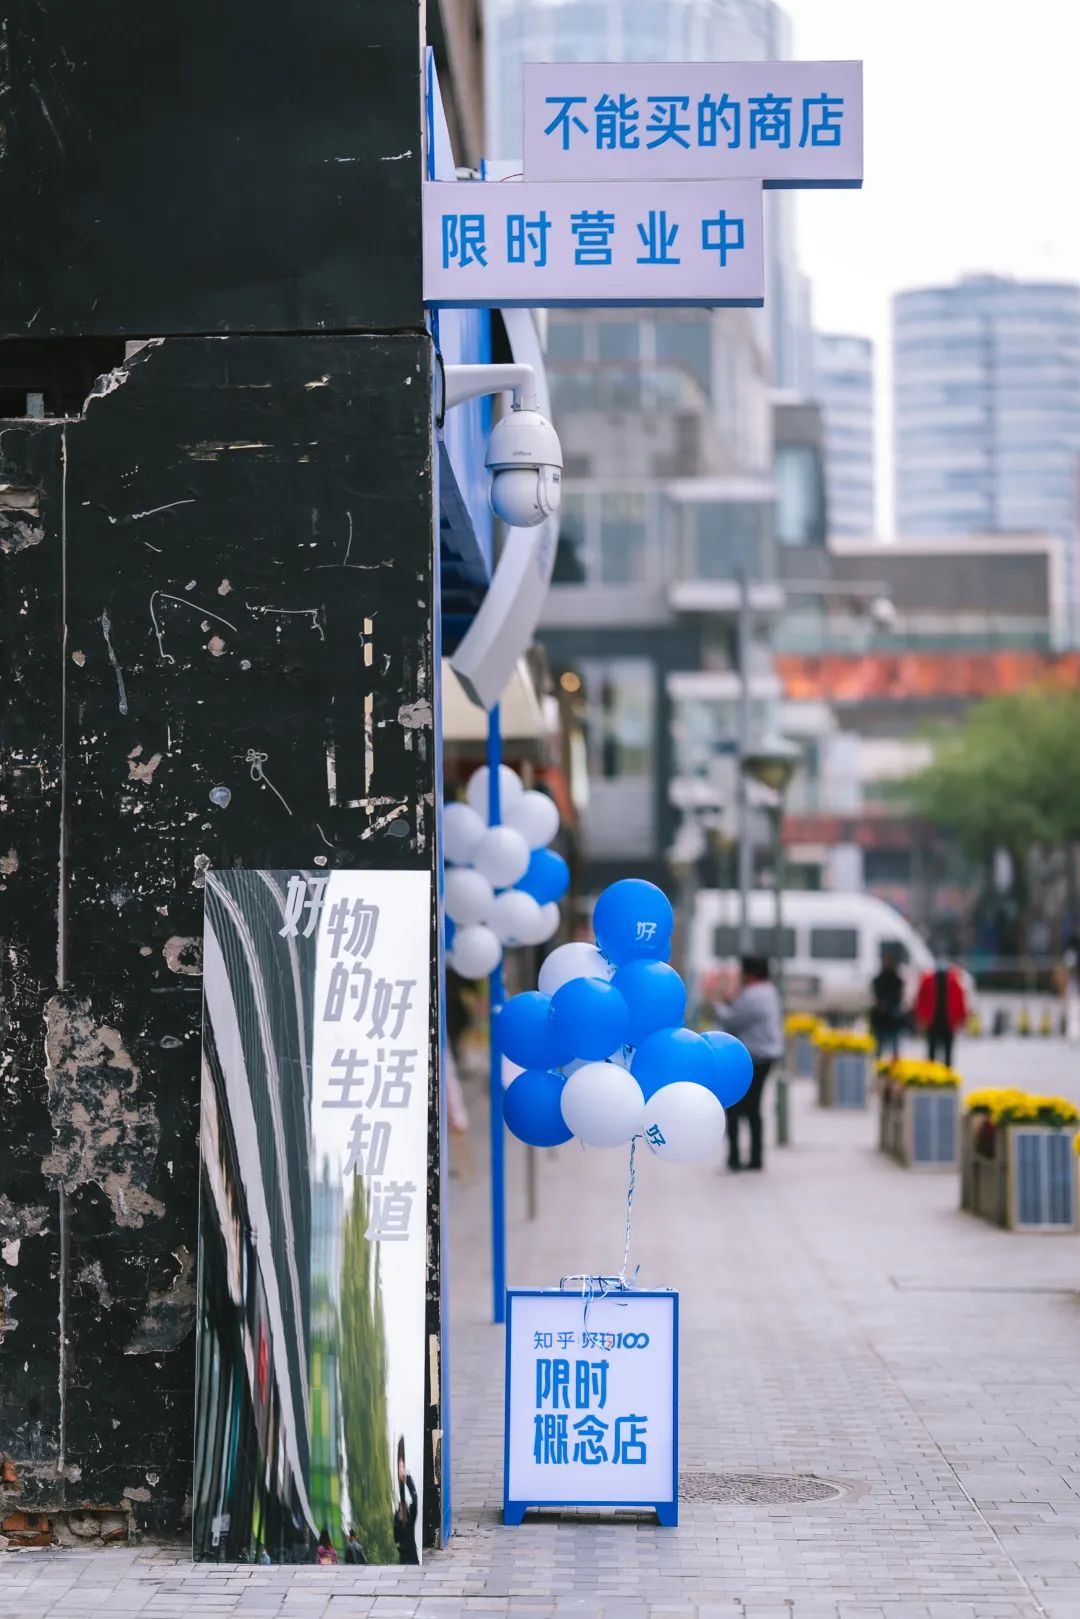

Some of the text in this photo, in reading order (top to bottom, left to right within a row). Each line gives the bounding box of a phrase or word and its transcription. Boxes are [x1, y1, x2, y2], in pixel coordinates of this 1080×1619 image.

[544, 93, 844, 150] 不能买的商店
[441, 210, 745, 269] 限时营业中
[279, 875, 380, 959] 好物
[635, 921, 657, 941] 好
[323, 961, 417, 1040] 的好
[321, 1048, 418, 1109] 生活
[533, 1331, 574, 1349] 知乎
[536, 1359, 609, 1409] 限时
[533, 1414, 648, 1464] 概念店
